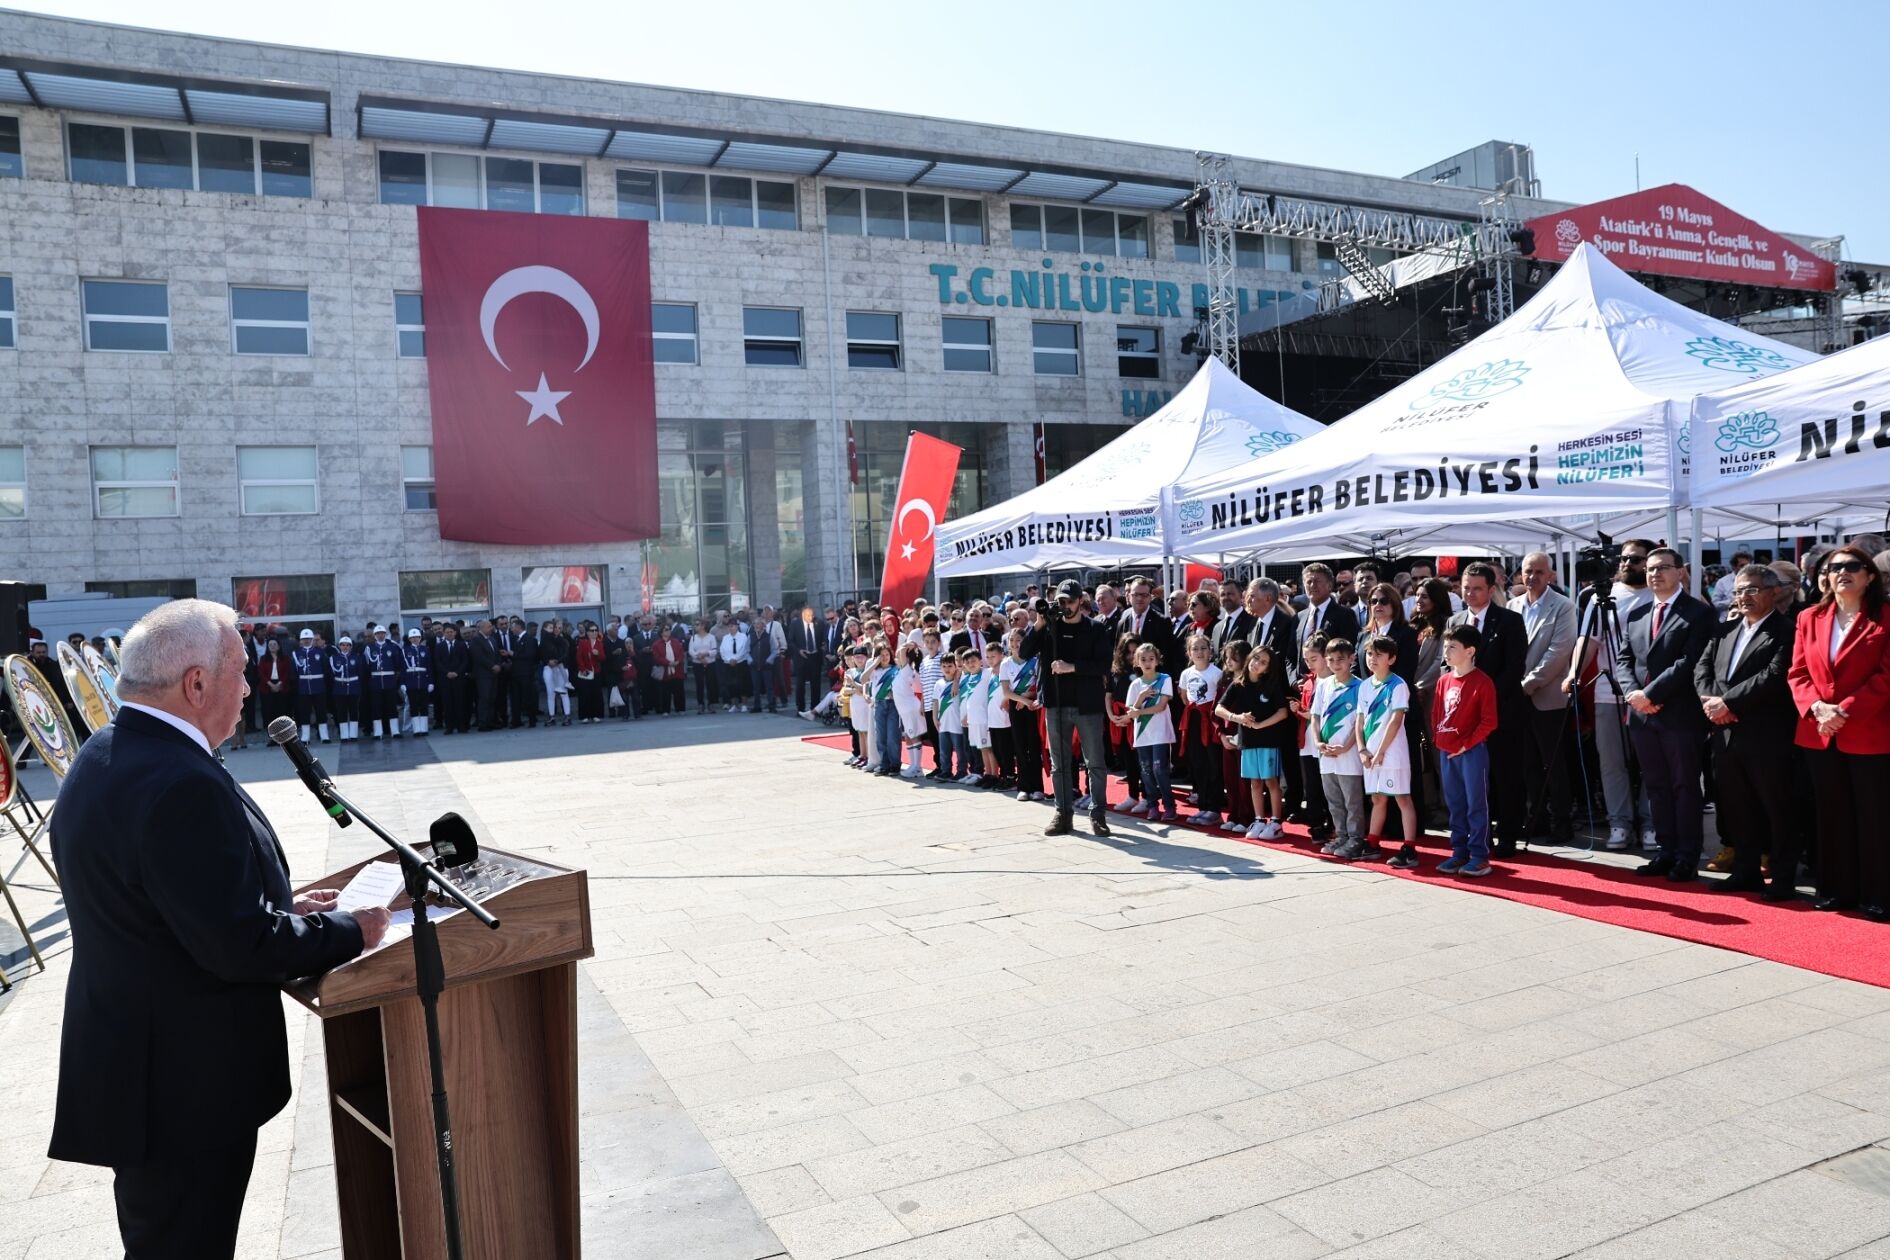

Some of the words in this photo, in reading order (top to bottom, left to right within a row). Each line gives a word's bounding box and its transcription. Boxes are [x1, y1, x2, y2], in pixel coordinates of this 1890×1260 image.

[1658, 205, 1674, 220] 19
[1677, 207, 1713, 227] Mayıs
[1666, 224, 1706, 246] Anma,
[1708, 230, 1754, 252] Gençlik
[1755, 240, 1768, 252] ve
[1593, 234, 1626, 255] Spor
[1706, 249, 1740, 267] Kutlu
[1742, 253, 1776, 271] Olsun
[1393, 401, 1490, 424] NİLÜFER
[1558, 434, 1613, 451] HERKESİN
[1616, 428, 1642, 443] SESİ
[1558, 444, 1643, 468] HEPİMİZİN
[1720, 450, 1776, 464] NİLÜFER
[1557, 461, 1644, 485] NİLÜFER'İ
[1211, 484, 1324, 530] NİLÜFER
[1334, 445, 1540, 510] BELEDİYESİ
[1120, 515, 1156, 527] HEPİMİZİN
[955, 530, 1014, 559] NİLÜFER
[1018, 510, 1112, 547] BELEDİYESİ
